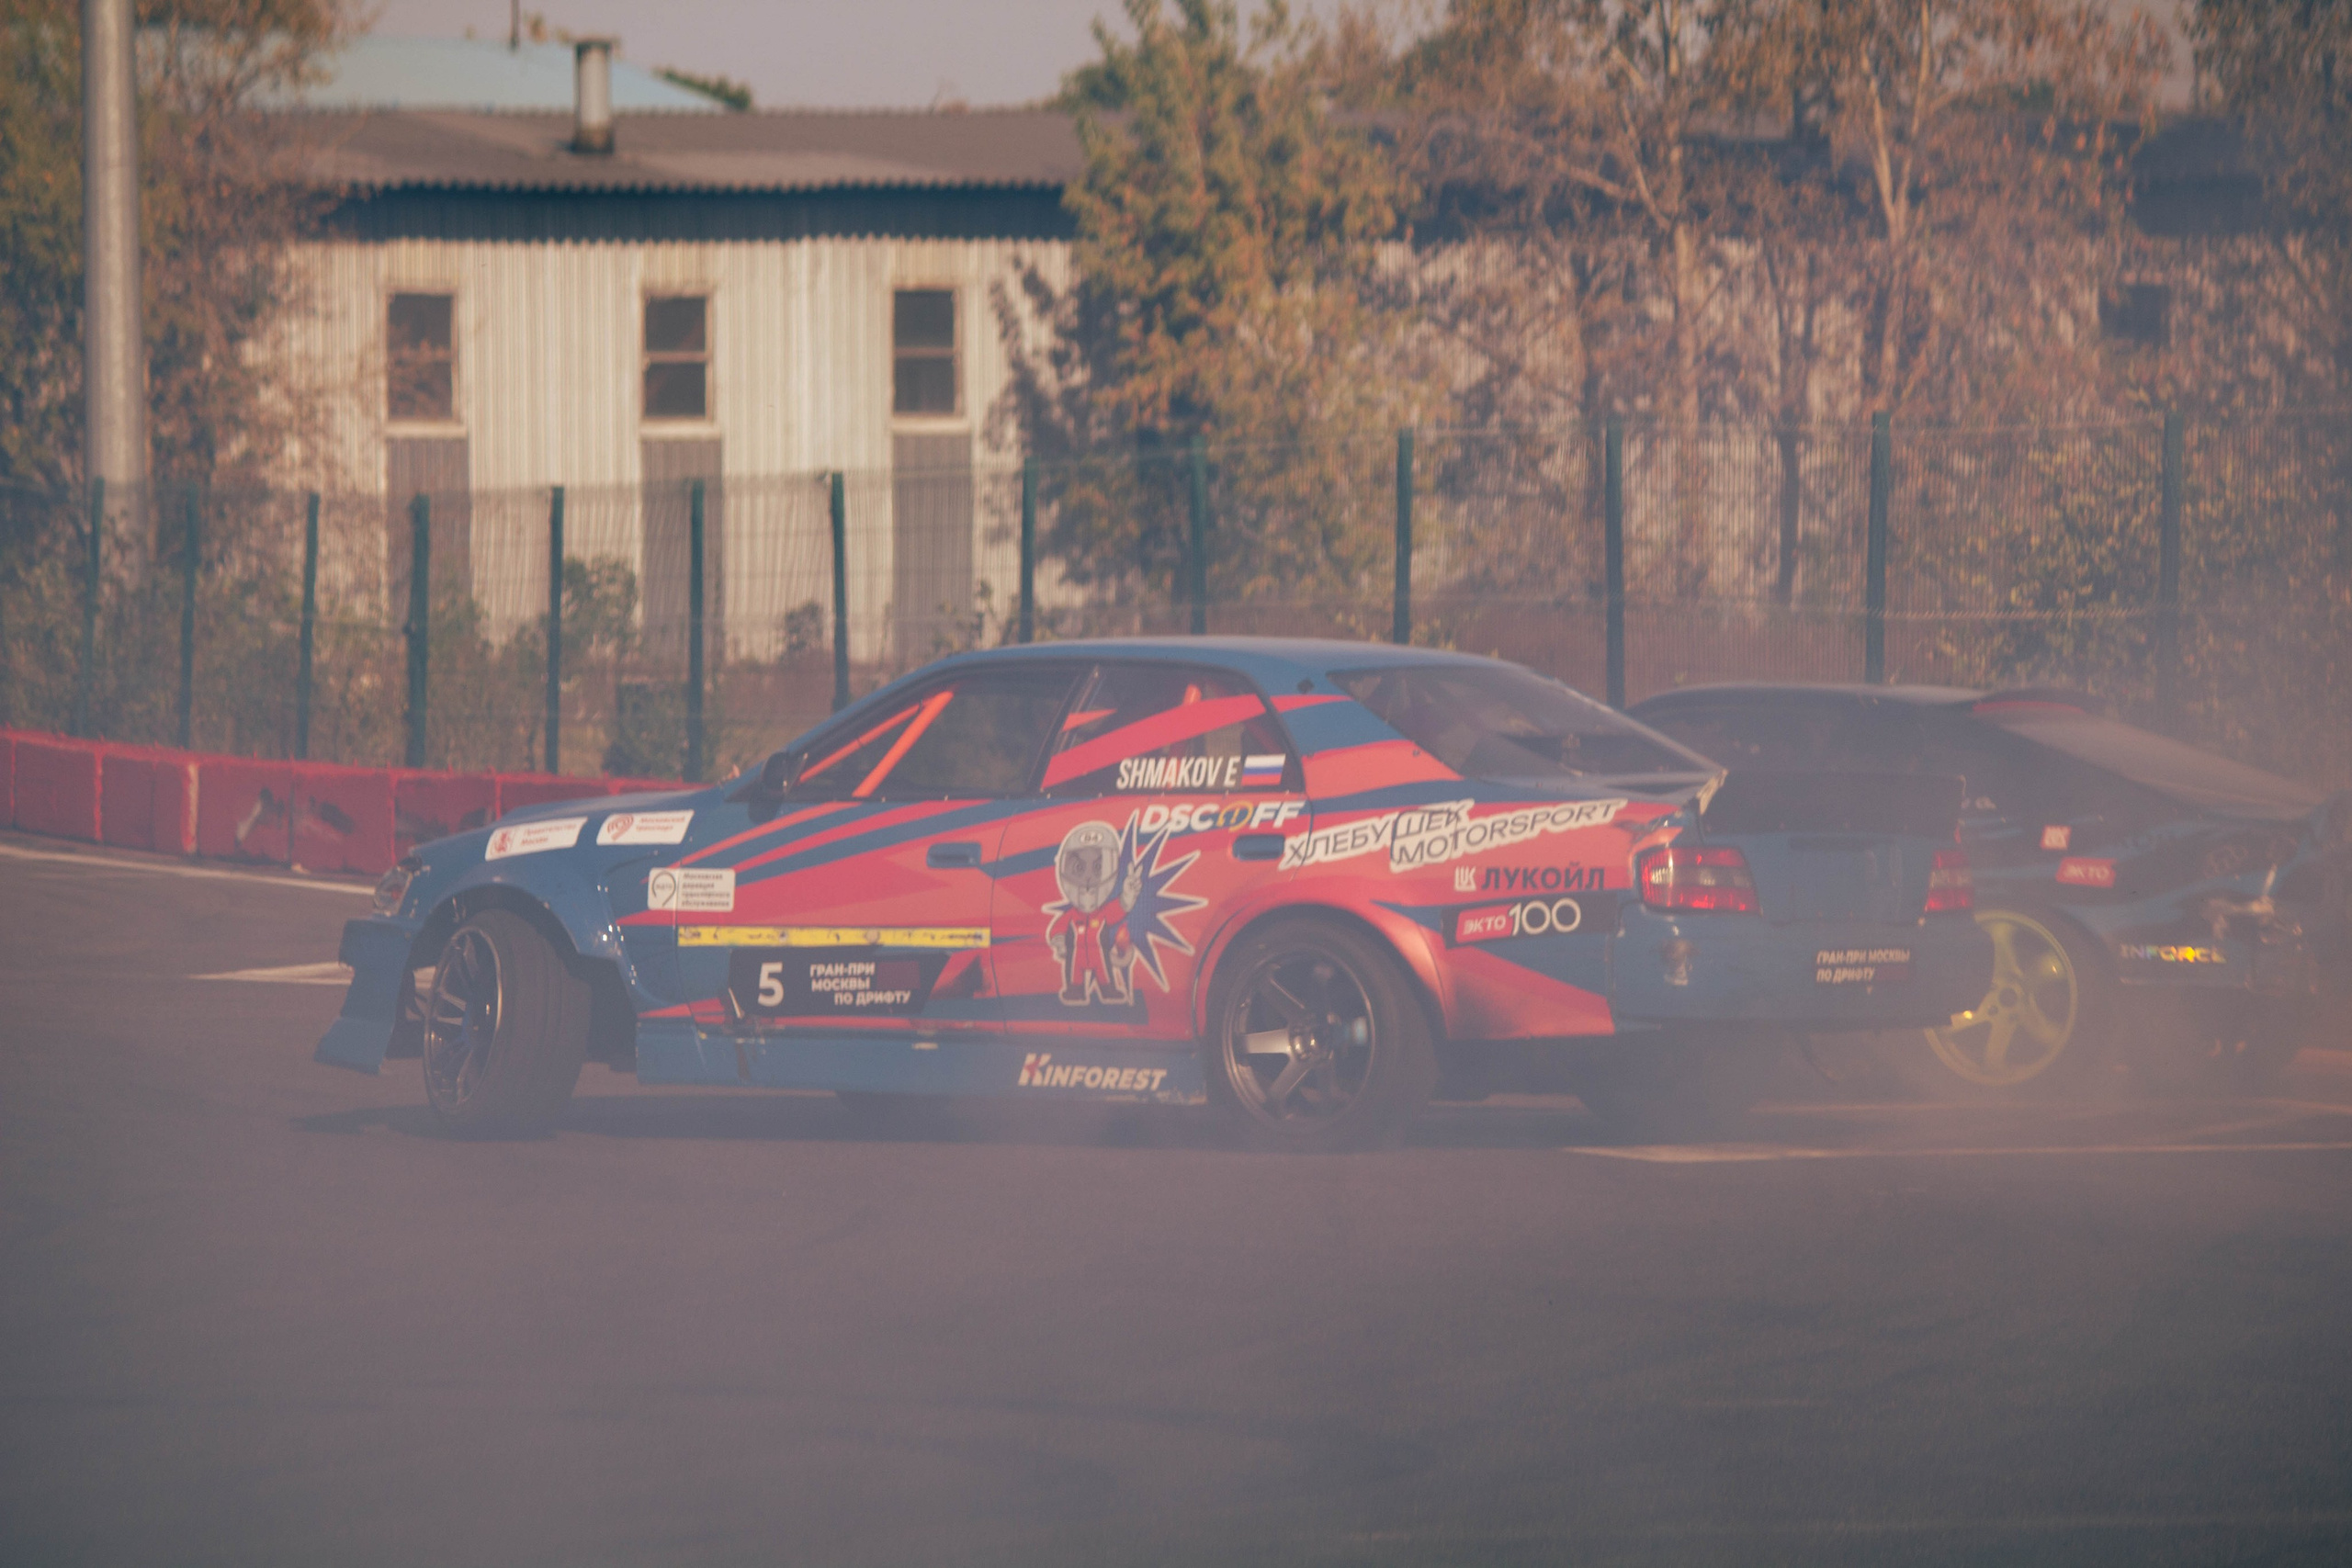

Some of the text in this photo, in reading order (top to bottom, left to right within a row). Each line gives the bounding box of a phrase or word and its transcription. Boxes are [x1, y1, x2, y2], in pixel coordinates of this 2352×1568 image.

[1116, 755, 1241, 789] SHMAKOV E
[1396, 799, 1622, 866] MOTORSPORT
[1481, 862, 1606, 890] ЛУКОЙЛ
[1463, 897, 1581, 936] ЭКТО 100
[758, 962, 784, 1007] 5
[809, 962, 876, 977] ГРАН-ПРИ
[811, 976, 871, 991] МОСКВЫ
[1816, 967, 1833, 983] ПО
[834, 990, 911, 1006] ПО ДРИФТУ
[1018, 1053, 1168, 1091] KINFOREST
